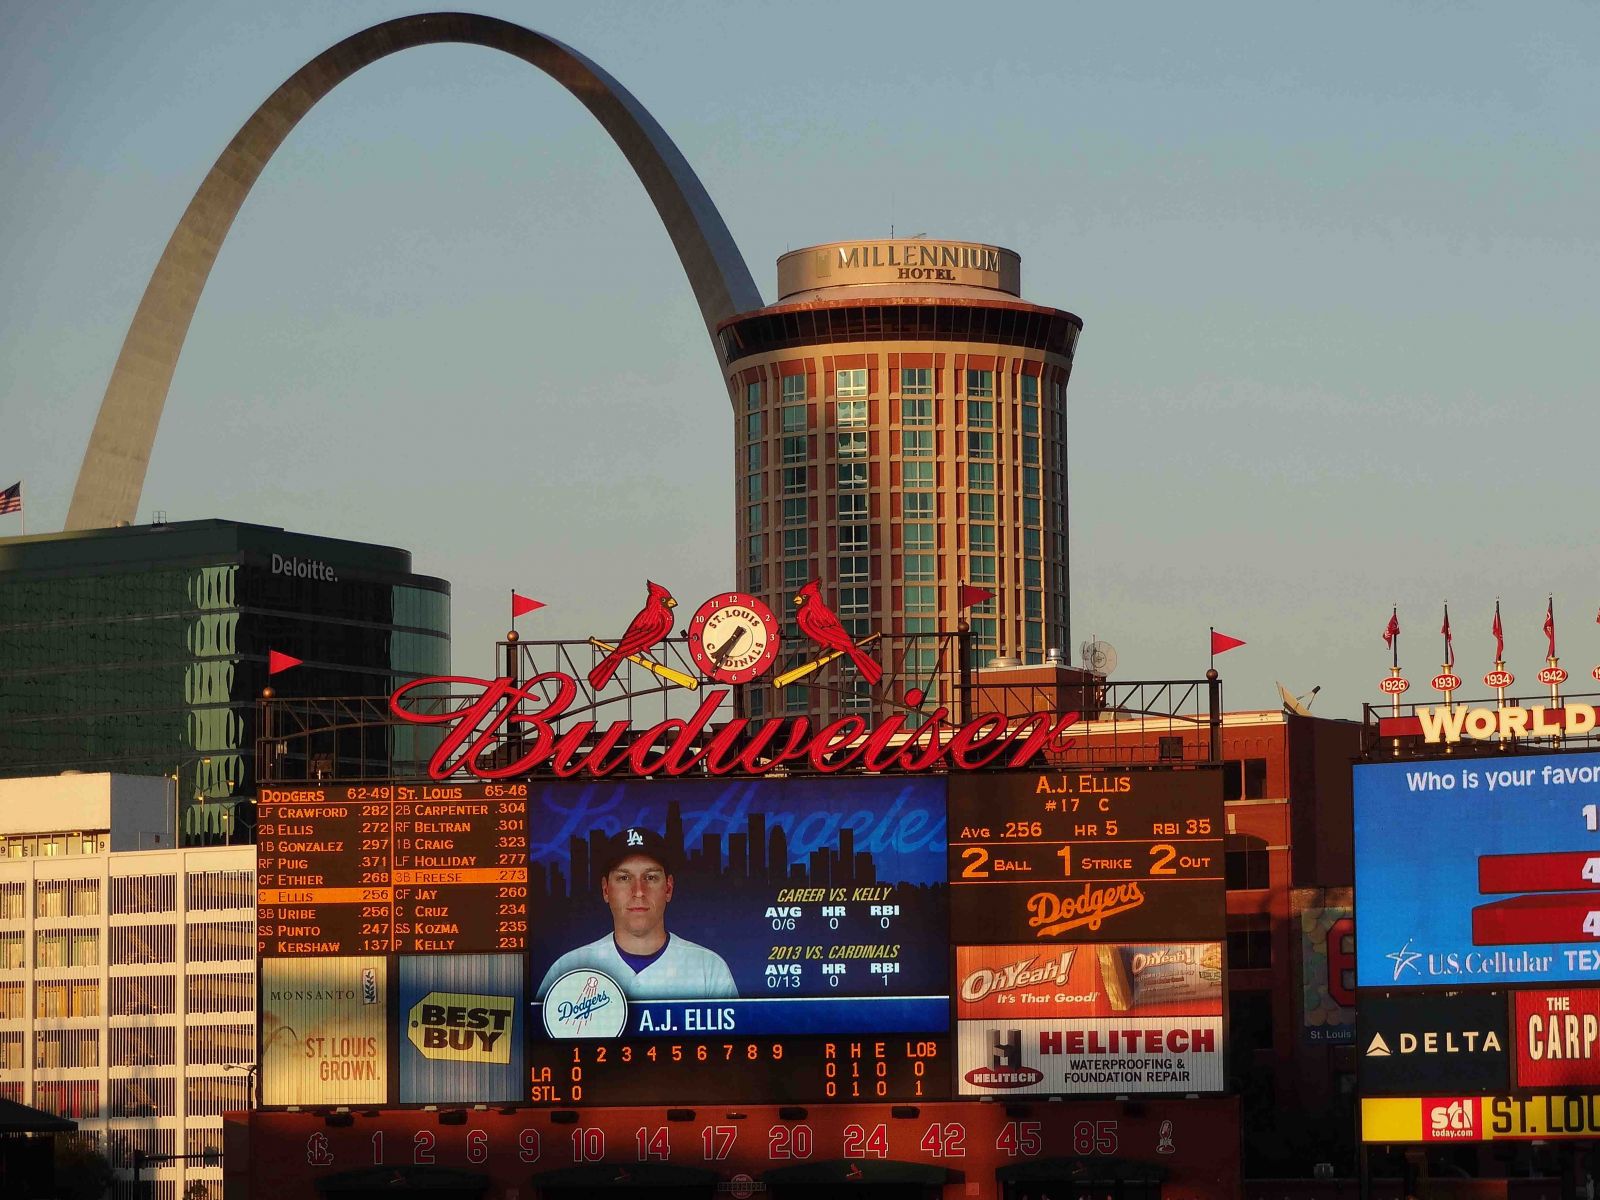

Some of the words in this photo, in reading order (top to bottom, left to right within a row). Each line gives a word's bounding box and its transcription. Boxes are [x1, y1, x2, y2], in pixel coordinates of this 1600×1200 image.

[838, 245, 1000, 272] MILLENNIUM
[898, 268, 956, 280] HOTEL
[272, 553, 338, 582] Deloitte.
[709, 615, 725, 629] ST.
[725, 609, 760, 627] LOUIS
[1434, 676, 1455, 688] 1931
[1487, 672, 1510, 684] 1934
[1540, 669, 1562, 680] 1942
[1382, 679, 1405, 691] 1926
[391, 672, 1080, 781] Budweiser
[1416, 703, 1596, 744] WORLD
[1036, 776, 1072, 793] A.J.
[1079, 774, 1130, 793] ELLIS
[1407, 772, 1455, 792] Who
[1462, 769, 1479, 789] is
[1485, 769, 1535, 790] your
[262, 790, 325, 802] DODGERS
[347, 788, 390, 799] 62-49
[398, 789, 418, 800] ST.
[423, 787, 462, 799] LOUIS
[485, 785, 527, 796] 65-46
[278, 807, 347, 818] CRAWFORD
[358, 805, 388, 816] .282
[415, 804, 488, 816] CARPENTER
[495, 803, 525, 813] .304
[1045, 798, 1079, 812] #17
[1099, 798, 1109, 811] C
[278, 824, 313, 835] ELLIS
[359, 822, 388, 833] .272
[415, 822, 470, 832] BELTRAN
[495, 820, 523, 830] .301
[961, 827, 990, 838] AVG
[1001, 822, 1042, 838] .256
[1075, 825, 1097, 836] HR
[1106, 820, 1117, 835] 5
[1154, 823, 1179, 834] RBI
[1186, 818, 1211, 834] 35
[278, 841, 343, 852] GONZALEZ
[358, 839, 388, 850] .297
[415, 839, 453, 849] CRAIG
[496, 837, 525, 847] .323
[278, 858, 308, 869] PUIG
[358, 856, 386, 867] .371
[415, 856, 476, 866] HOLLIDAY
[496, 854, 525, 864] .277
[962, 847, 988, 878] 2
[995, 860, 1031, 871] BALL
[1057, 845, 1070, 876] 1
[1082, 858, 1132, 869] STRIKE
[1150, 843, 1176, 874] 2
[1180, 856, 1210, 867] OUT
[278, 874, 323, 885] ETHIER
[358, 873, 389, 883] .268
[496, 871, 525, 881] .273
[415, 889, 437, 900] JAY
[496, 887, 527, 897] .260
[778, 889, 826, 902] CAREER
[829, 889, 847, 901] VS.
[852, 888, 893, 901] KELLY
[278, 908, 316, 919] URIBE
[359, 907, 389, 917] .256
[415, 906, 448, 917] CRUZ
[496, 904, 526, 914] .234
[765, 907, 801, 918] AVG
[822, 906, 846, 917] HR
[870, 905, 899, 916] RBI
[1027, 882, 1144, 937] Dodgers
[278, 925, 320, 936] PUNTO
[359, 924, 388, 934] .247
[415, 923, 459, 934] KOZMA
[496, 921, 526, 932] .235
[772, 918, 795, 931] 0/6
[278, 942, 340, 952] KERSHAW
[359, 940, 388, 950] .137
[415, 939, 454, 950] KELLY
[496, 937, 523, 948] .231
[768, 946, 802, 960] 2013
[805, 946, 824, 959] VS.
[828, 945, 900, 959] CARDINALS
[765, 964, 801, 975] AVG
[822, 964, 846, 975] HR
[870, 963, 899, 974] RBI
[1428, 952, 1463, 975] U.S.
[1465, 951, 1553, 973] Cellular
[768, 975, 800, 989] 0/13
[271, 990, 355, 1000] MONSANTO
[998, 994, 1015, 1003] It's
[1021, 994, 1050, 1003] That
[1055, 992, 1097, 1003] Good!
[559, 992, 612, 1022] Dodgers
[1546, 997, 1570, 1011] THE
[421, 1004, 511, 1030] BEST
[639, 1011, 677, 1032] A.J.
[686, 1009, 735, 1031] ELLIS
[424, 1027, 503, 1052] BUY
[1040, 1029, 1214, 1054] HELITECH
[1310, 1031, 1323, 1039] St.
[1327, 1030, 1352, 1038] Louis
[1529, 1014, 1598, 1060] CARP
[306, 1038, 327, 1058] ST.
[332, 1037, 376, 1057] LOUIS
[1400, 1032, 1501, 1053] DELTA
[574, 1048, 580, 1062] 1
[597, 1047, 606, 1062] 2
[622, 1047, 631, 1061] 3
[647, 1047, 656, 1061] 4
[672, 1046, 681, 1061] 5
[697, 1046, 707, 1060] 6
[724, 1045, 732, 1060] 7
[748, 1045, 757, 1059] 8
[773, 1044, 782, 1059] 9
[826, 1044, 835, 1058] R
[851, 1043, 860, 1058] H
[876, 1043, 885, 1058] E
[907, 1042, 936, 1057] LOB
[320, 1061, 380, 1081] GROWN.
[1070, 1059, 1172, 1070] WATERPROOFING
[1177, 1059, 1185, 1069] &
[532, 1067, 551, 1082] LA
[974, 1073, 1036, 1083] HELITECH
[1064, 1072, 1142, 1083] FOUNDATION
[1147, 1071, 1190, 1082] REPAIR
[532, 1086, 560, 1101] STL
[1431, 1100, 1472, 1129] stl
[1492, 1097, 1536, 1133] ST.
[768, 1124, 813, 1159] 20
[843, 1124, 888, 1158] 24
[921, 1123, 965, 1157] 42
[996, 1121, 1041, 1156] 45
[1073, 1121, 1118, 1155] 85
[1432, 1130, 1473, 1138] today.com
[372, 1131, 383, 1164] 1
[414, 1131, 435, 1164] 2
[467, 1130, 487, 1163] 6
[520, 1129, 540, 1163] 9
[572, 1128, 604, 1162] 10
[636, 1127, 671, 1161] 14
[701, 1125, 737, 1160] 17
